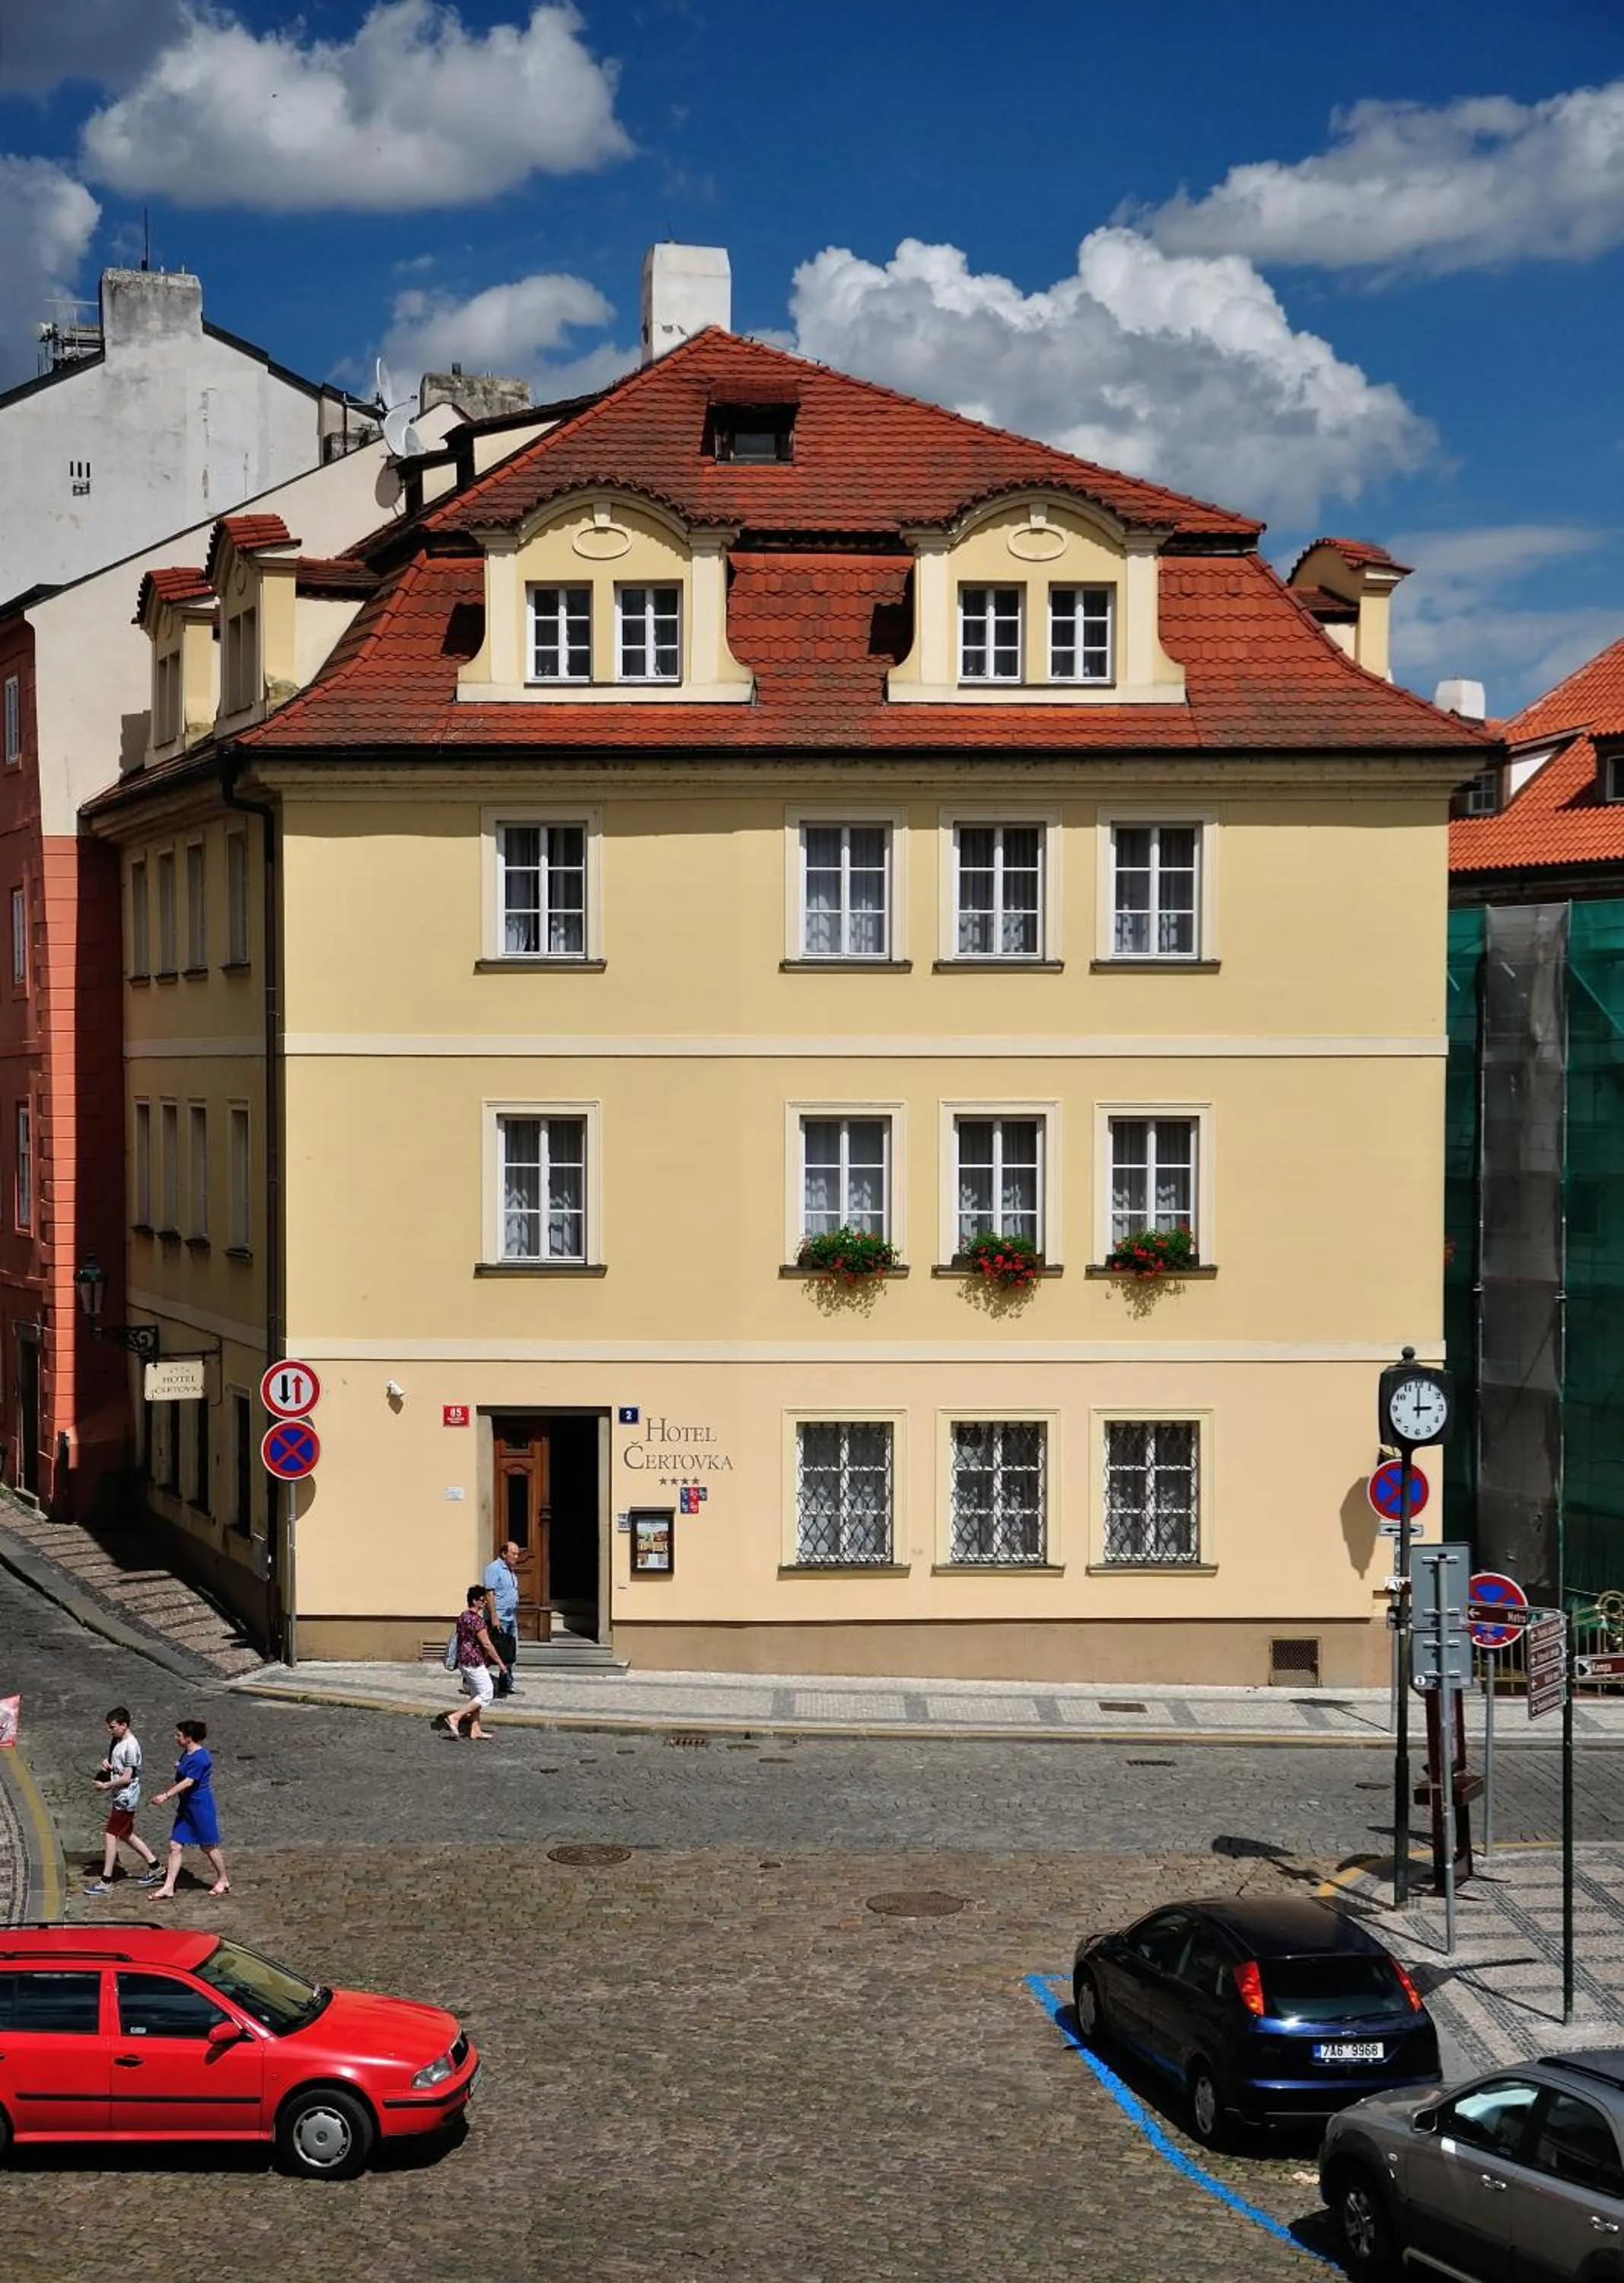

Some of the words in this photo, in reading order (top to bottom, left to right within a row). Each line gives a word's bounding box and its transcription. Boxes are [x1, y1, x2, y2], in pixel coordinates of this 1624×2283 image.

[626, 1410, 632, 1420] 2
[645, 1417, 718, 1442] HOTEL
[623, 1441, 734, 1470] ČERTOVKA
[1323, 2044, 1344, 2056] 7A6
